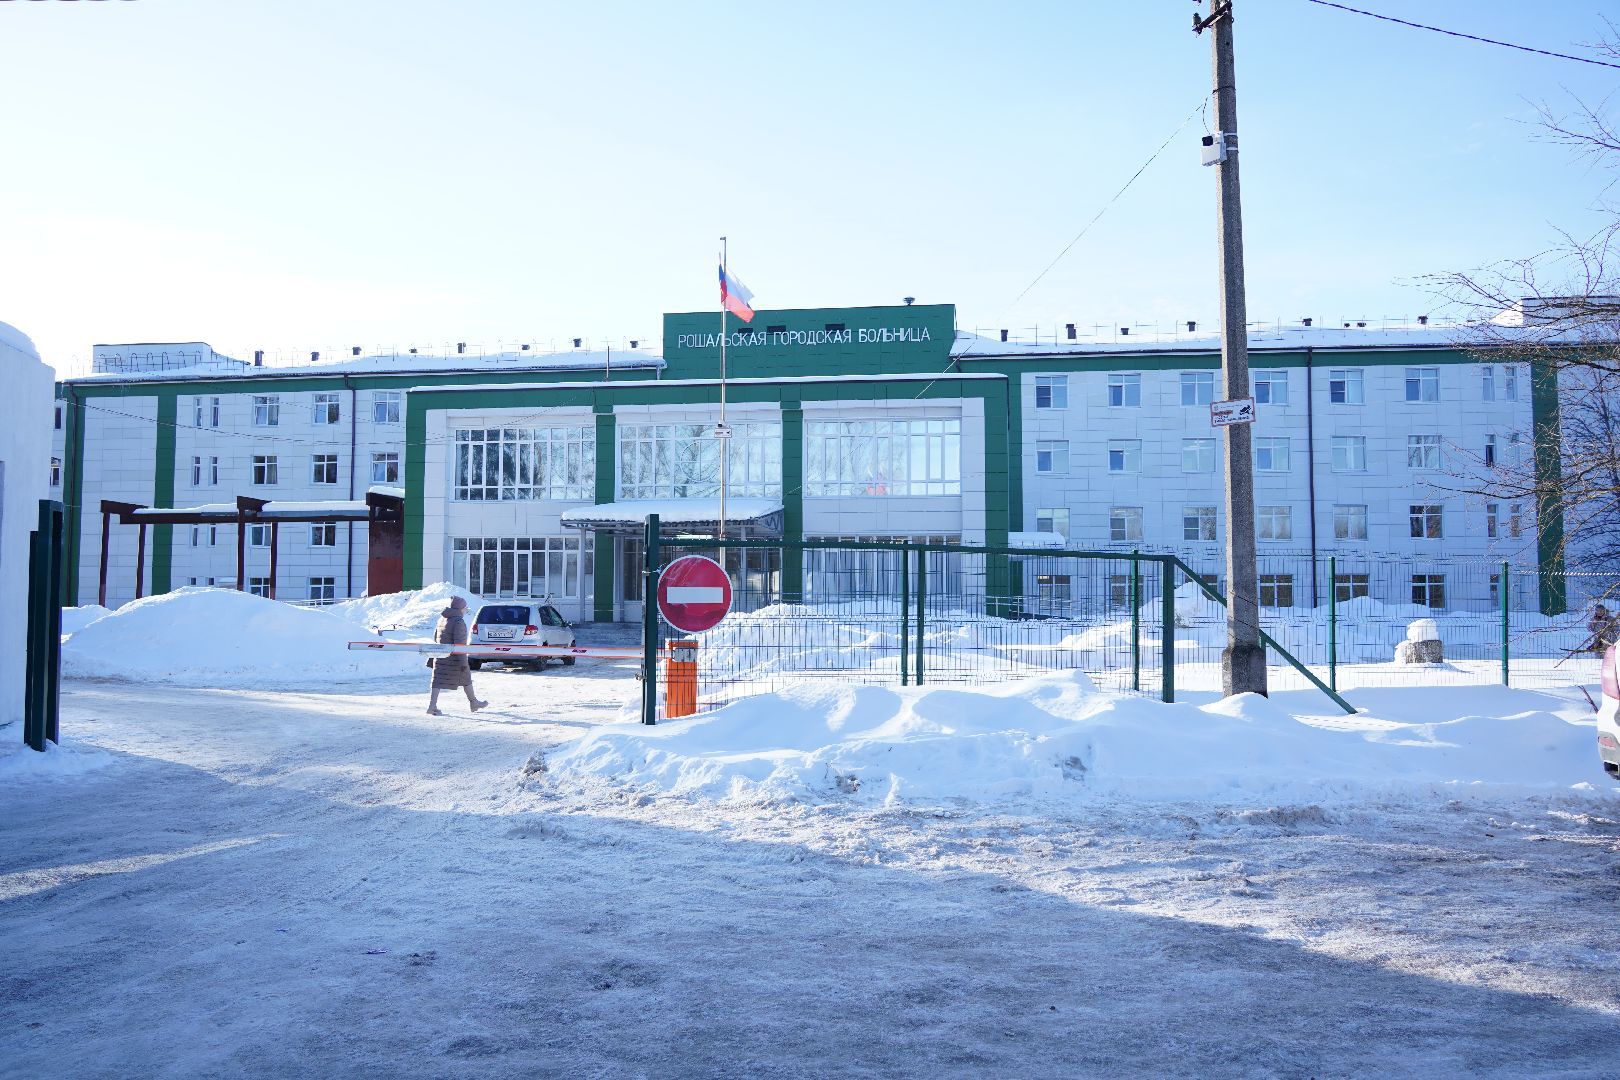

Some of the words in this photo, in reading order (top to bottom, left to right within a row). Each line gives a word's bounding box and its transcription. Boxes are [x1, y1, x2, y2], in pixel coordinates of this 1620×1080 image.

[678, 331, 767, 348] РОШАЛЬСКАЯ
[773, 329, 852, 346] ГОРОДСКАЯ
[858, 326, 931, 343] БОЛЬНИЦА
